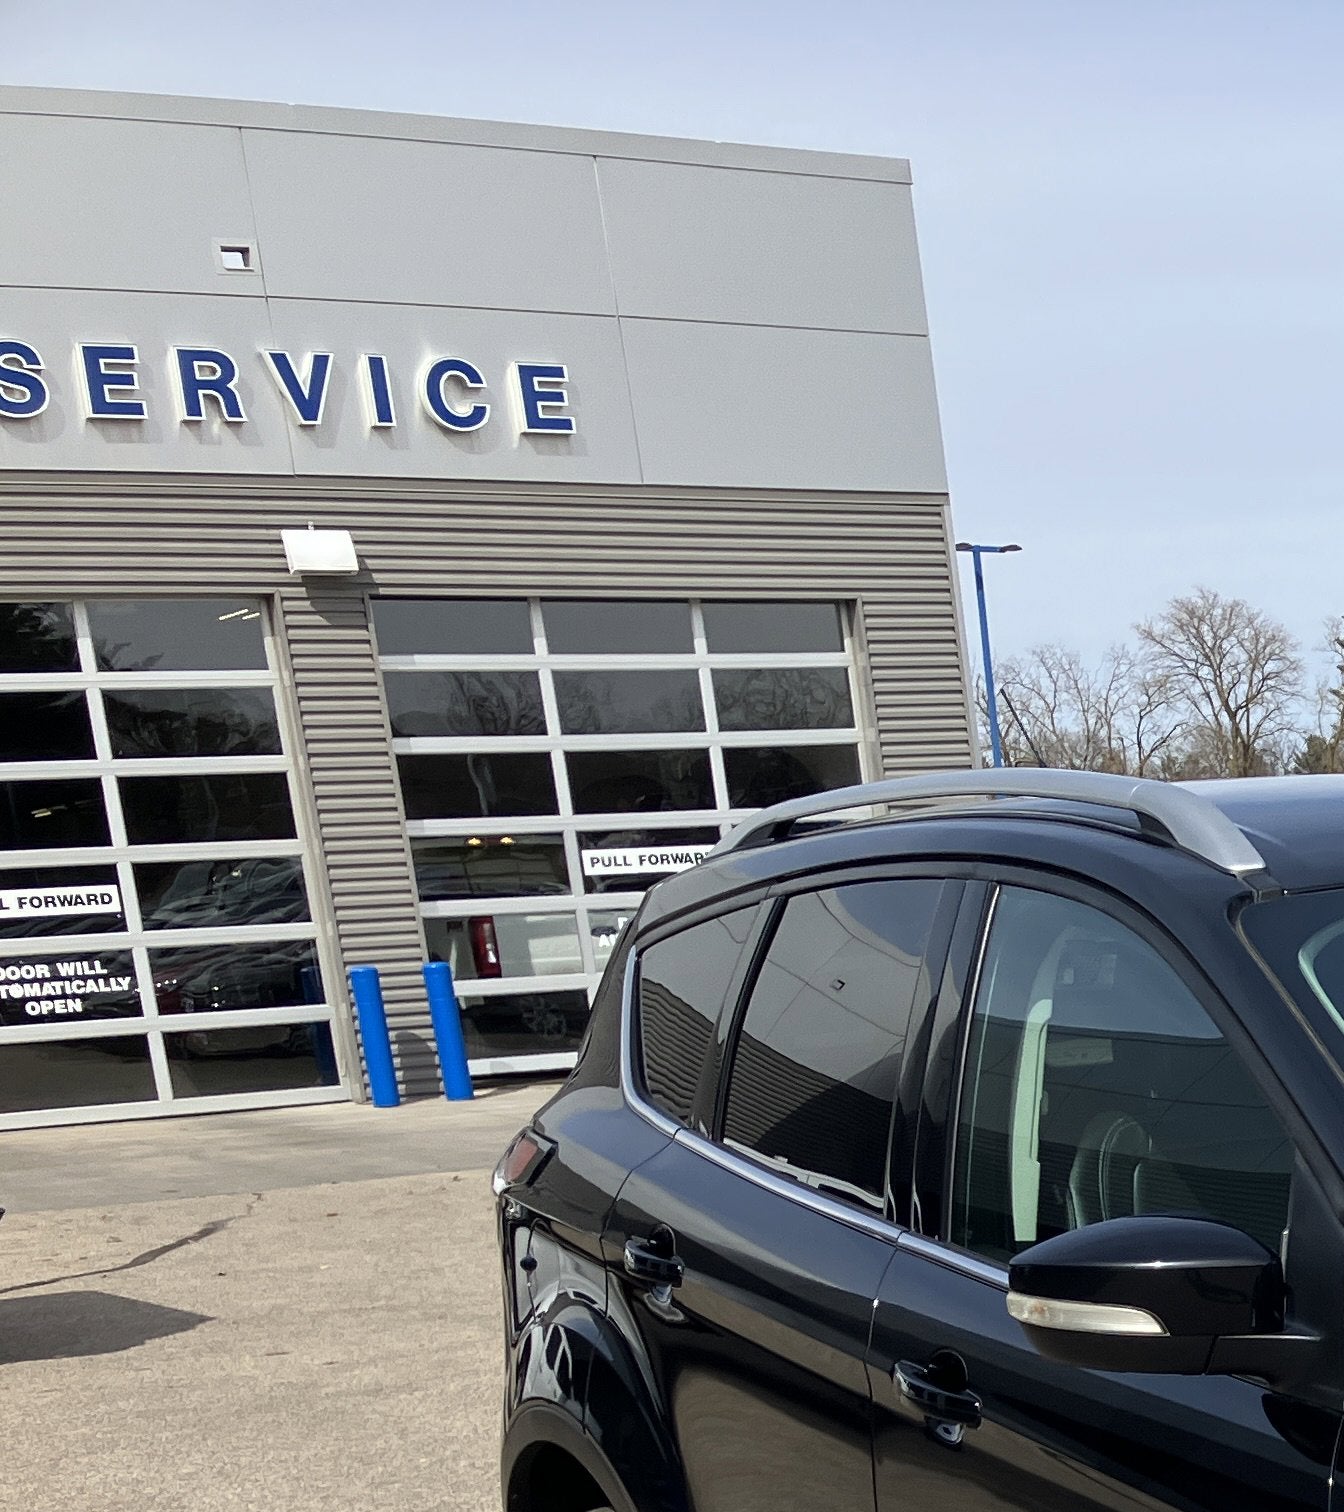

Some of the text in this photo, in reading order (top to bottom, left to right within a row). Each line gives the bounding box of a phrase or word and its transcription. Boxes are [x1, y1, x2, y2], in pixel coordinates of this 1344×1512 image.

[0, 339, 576, 434] SERVICE
[590, 851, 709, 868] PULL FORWAR
[17, 892, 113, 910] FORWARD
[56, 960, 108, 977] WILL
[25, 998, 83, 1016] OPEN
